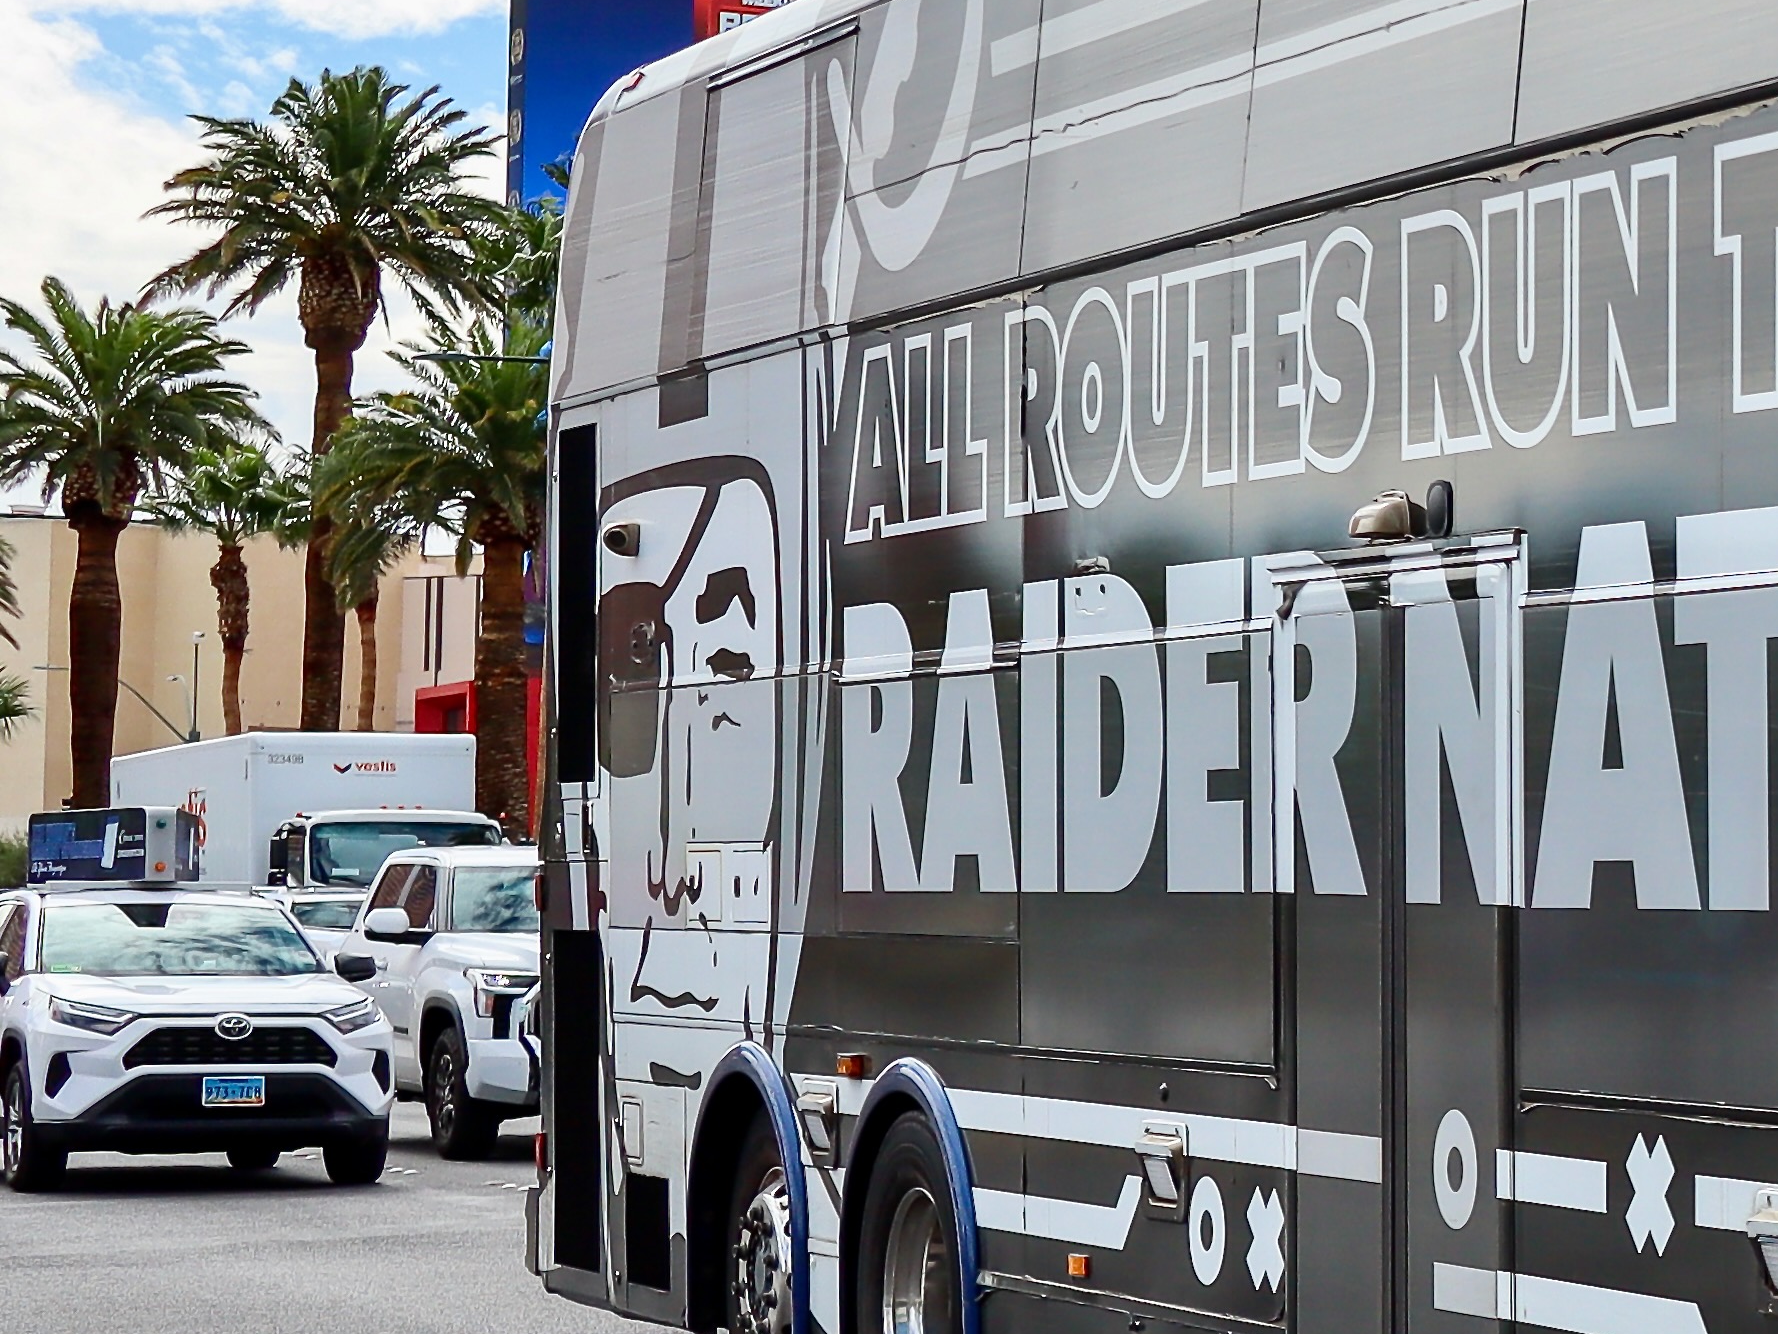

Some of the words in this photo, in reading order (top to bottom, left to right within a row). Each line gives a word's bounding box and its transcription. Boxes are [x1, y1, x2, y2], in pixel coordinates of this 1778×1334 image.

[843, 323, 988, 545] ALL
[1003, 225, 1376, 518] ROUTES
[1401, 154, 1677, 461] RUN
[841, 551, 1368, 897] RAIDER
